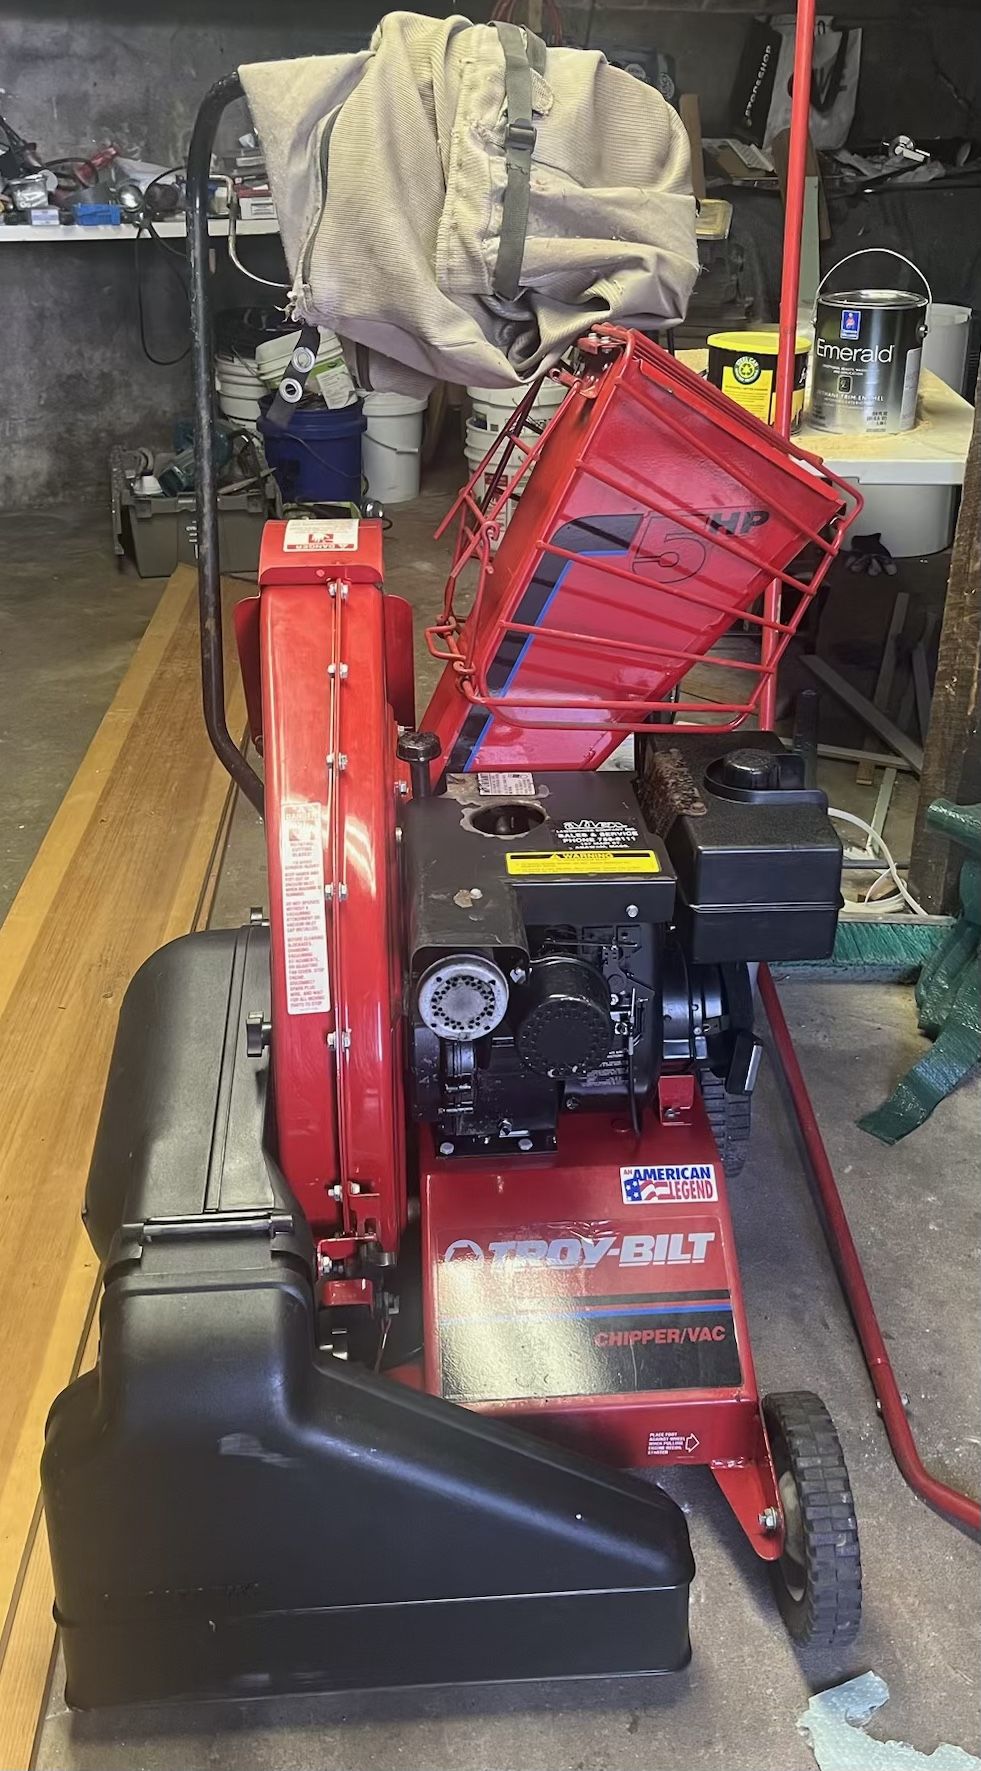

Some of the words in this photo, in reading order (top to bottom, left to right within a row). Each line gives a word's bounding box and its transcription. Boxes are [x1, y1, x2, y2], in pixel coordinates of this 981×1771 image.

[817, 338, 893, 363] Emerald
[632, 511, 708, 584] 5
[709, 510, 770, 536] HP
[633, 1167, 711, 1181] AMERICAN
[669, 1180, 713, 1200] LEGEND
[488, 1232, 715, 1270] TROY-BILT
[595, 1325, 726, 1347] CHIPPER/VAC
